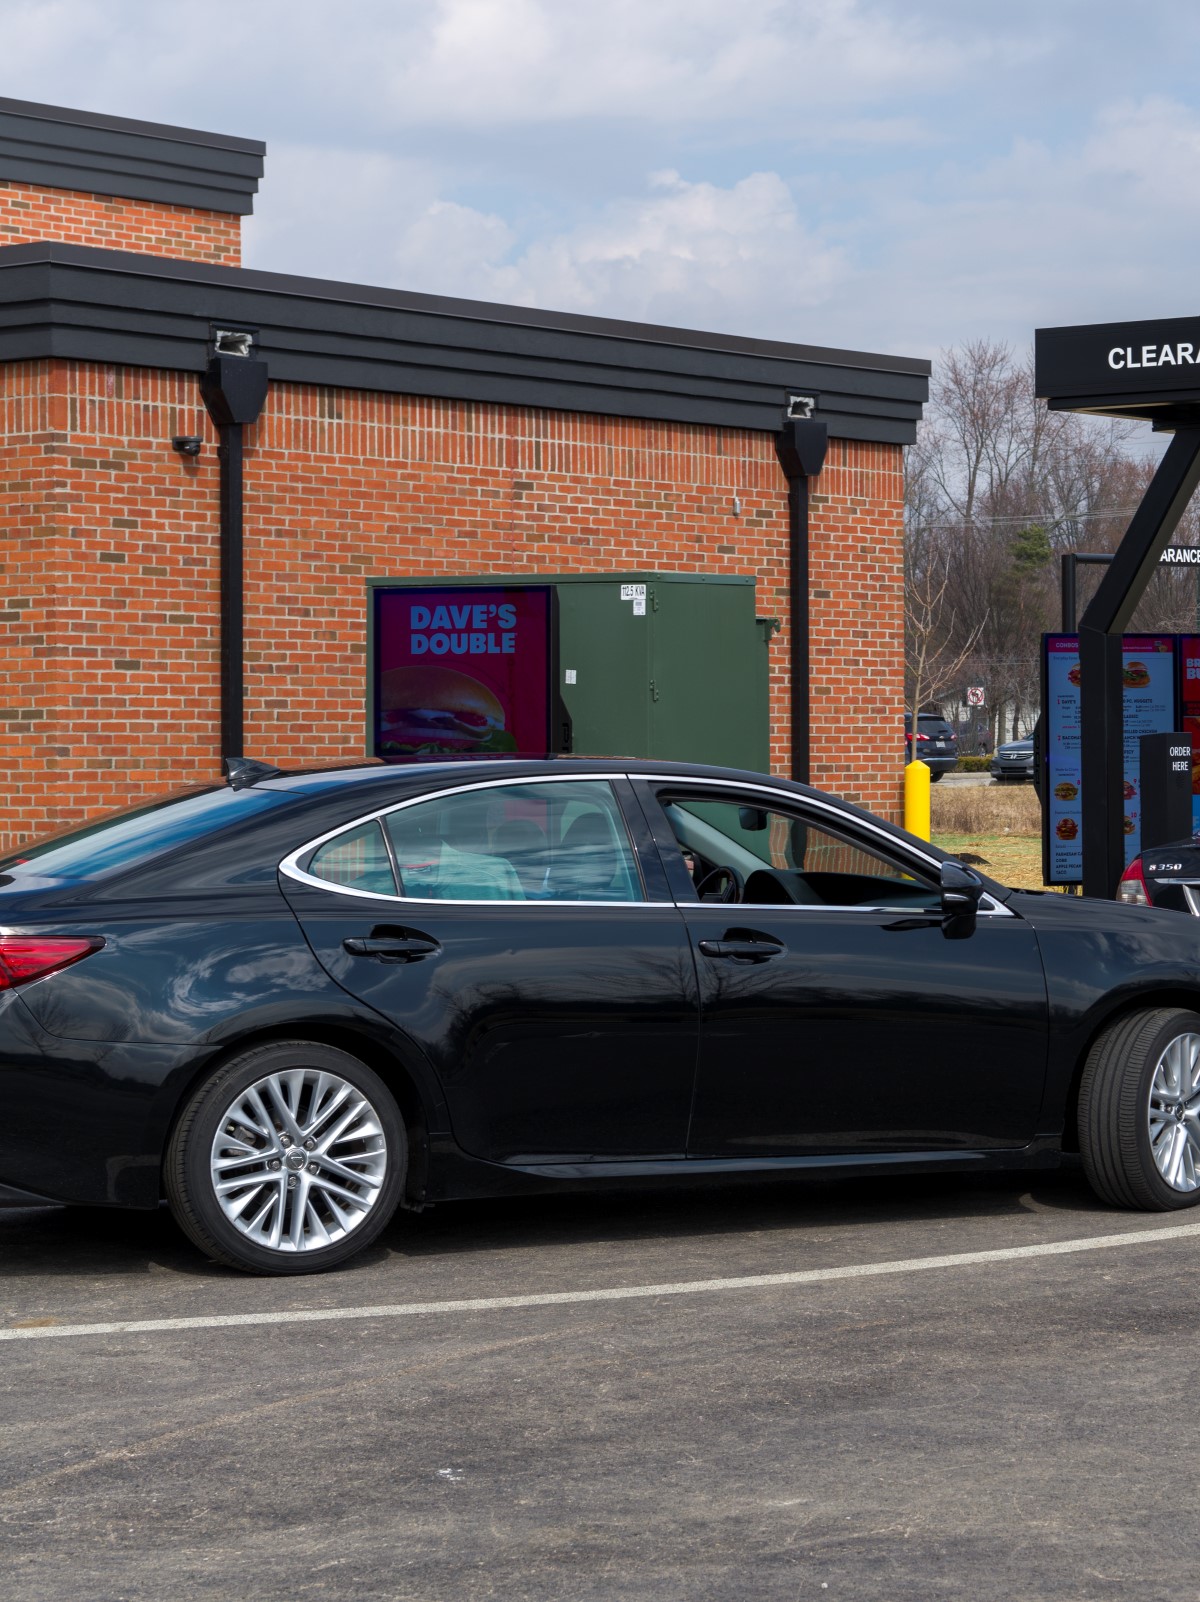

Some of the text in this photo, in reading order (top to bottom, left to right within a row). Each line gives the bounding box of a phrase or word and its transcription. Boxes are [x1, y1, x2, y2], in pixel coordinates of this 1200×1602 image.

[410, 603, 517, 630] DAVE'S
[410, 632, 517, 655] DOUBLE
[1169, 746, 1191, 756] ORDER
[1172, 761, 1189, 771] HERE
[1157, 863, 1182, 871] 350
